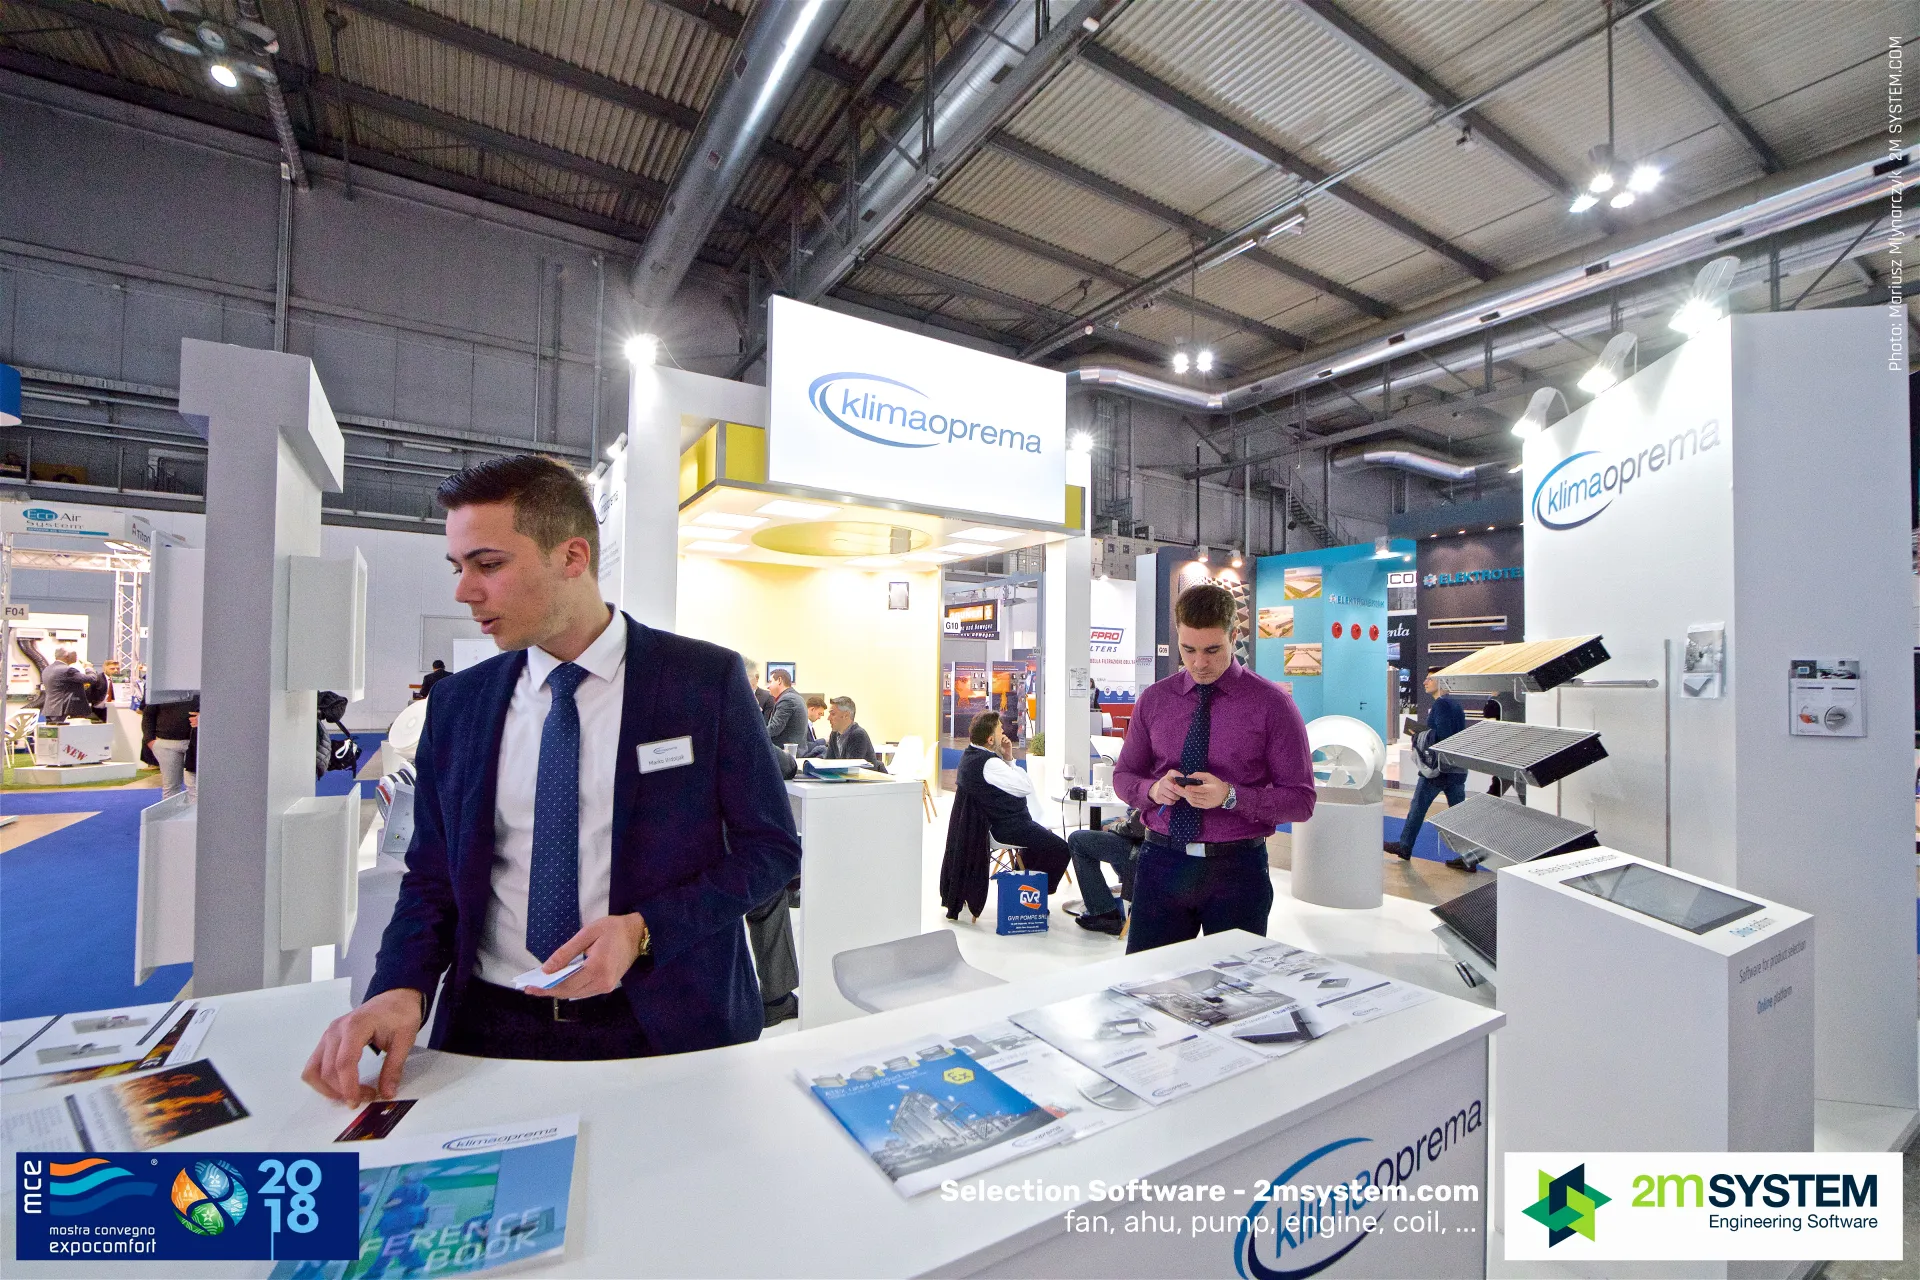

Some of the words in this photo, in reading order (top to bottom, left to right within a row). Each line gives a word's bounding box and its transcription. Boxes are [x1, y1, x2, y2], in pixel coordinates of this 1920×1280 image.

[841, 387, 1043, 455] klimaoprema
[1548, 416, 1721, 516] klimaoprema
[27, 509, 56, 521] Eco
[60, 512, 82, 522] Air
[1438, 567, 1525, 587] ELEKTROTE
[5, 607, 25, 616] F04
[945, 621, 959, 630] G10
[1090, 631, 1120, 641] FPRO
[1090, 645, 1118, 653] LTERS
[63, 744, 88, 761] NEW
[1020, 890, 1041, 904] GVR
[456, 1126, 558, 1149] klimaoprema
[1275, 1099, 1483, 1259] klimaoprema
[359, 1205, 543, 1258] FERENCE
[424, 1226, 540, 1274] BOOK
